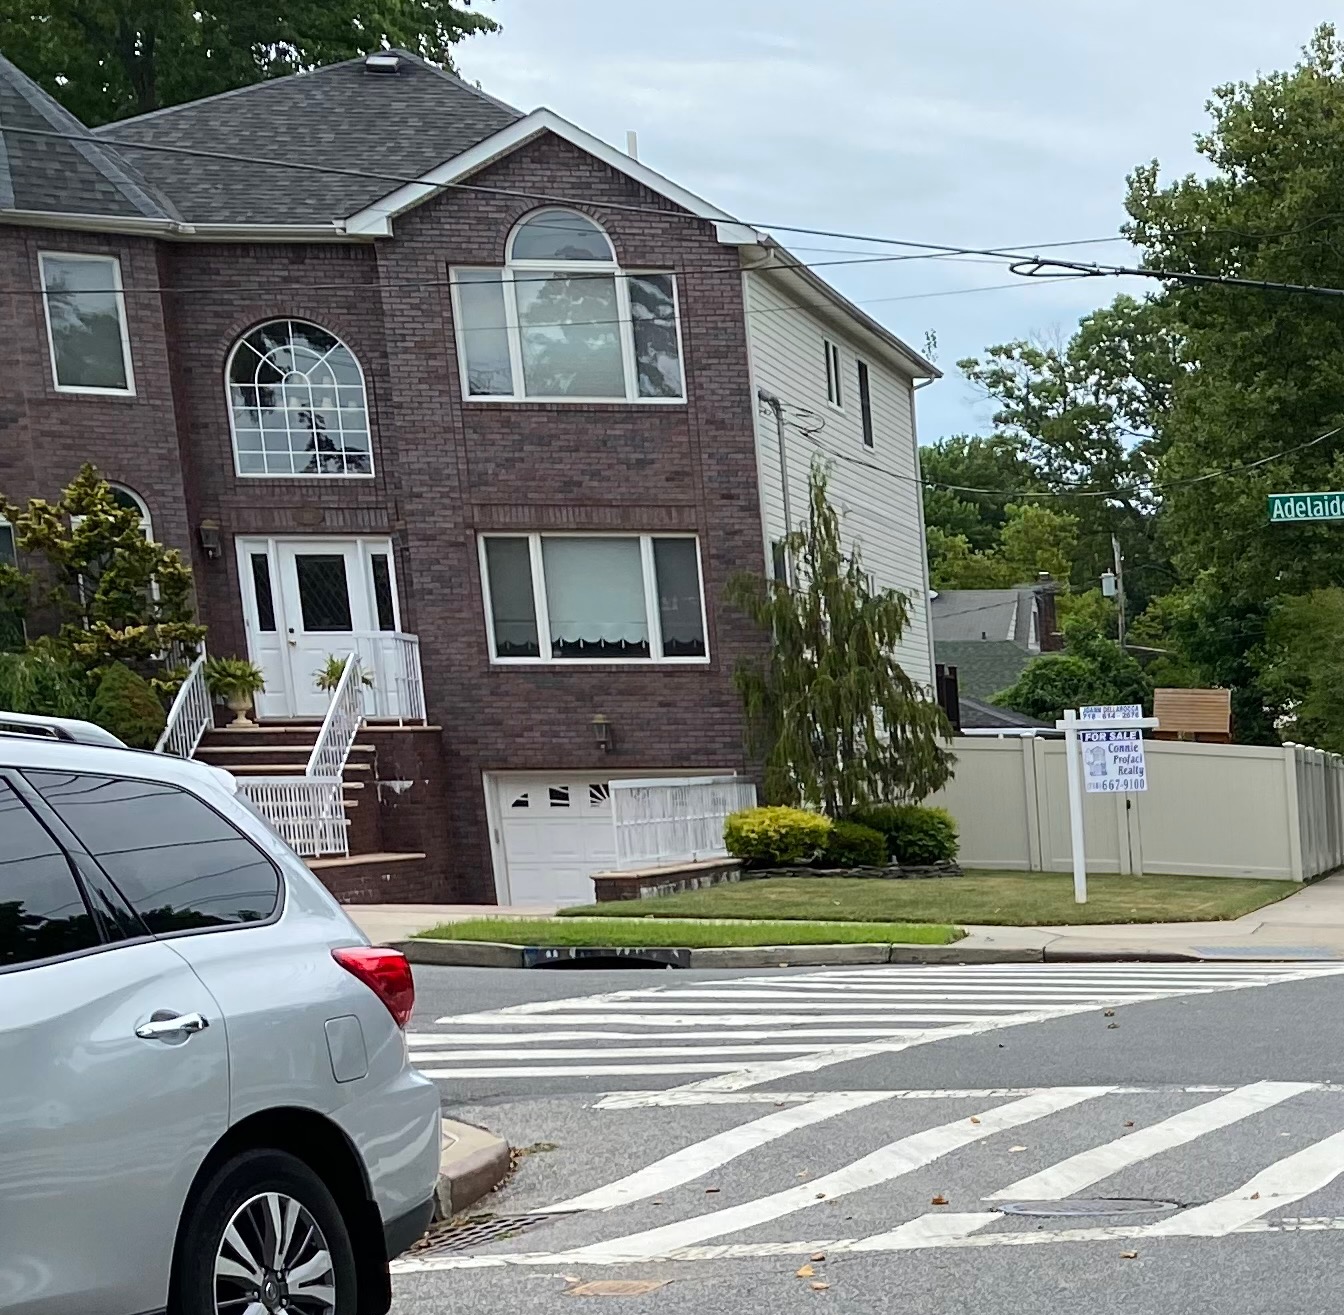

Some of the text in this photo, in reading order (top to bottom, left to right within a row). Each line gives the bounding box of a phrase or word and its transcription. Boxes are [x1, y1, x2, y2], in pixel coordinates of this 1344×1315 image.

[1084, 730, 1137, 742] FOR SALE
[1107, 742, 1139, 753] Connie
[1118, 765, 1144, 777] Realty
[1102, 778, 1145, 790] 667-9100
